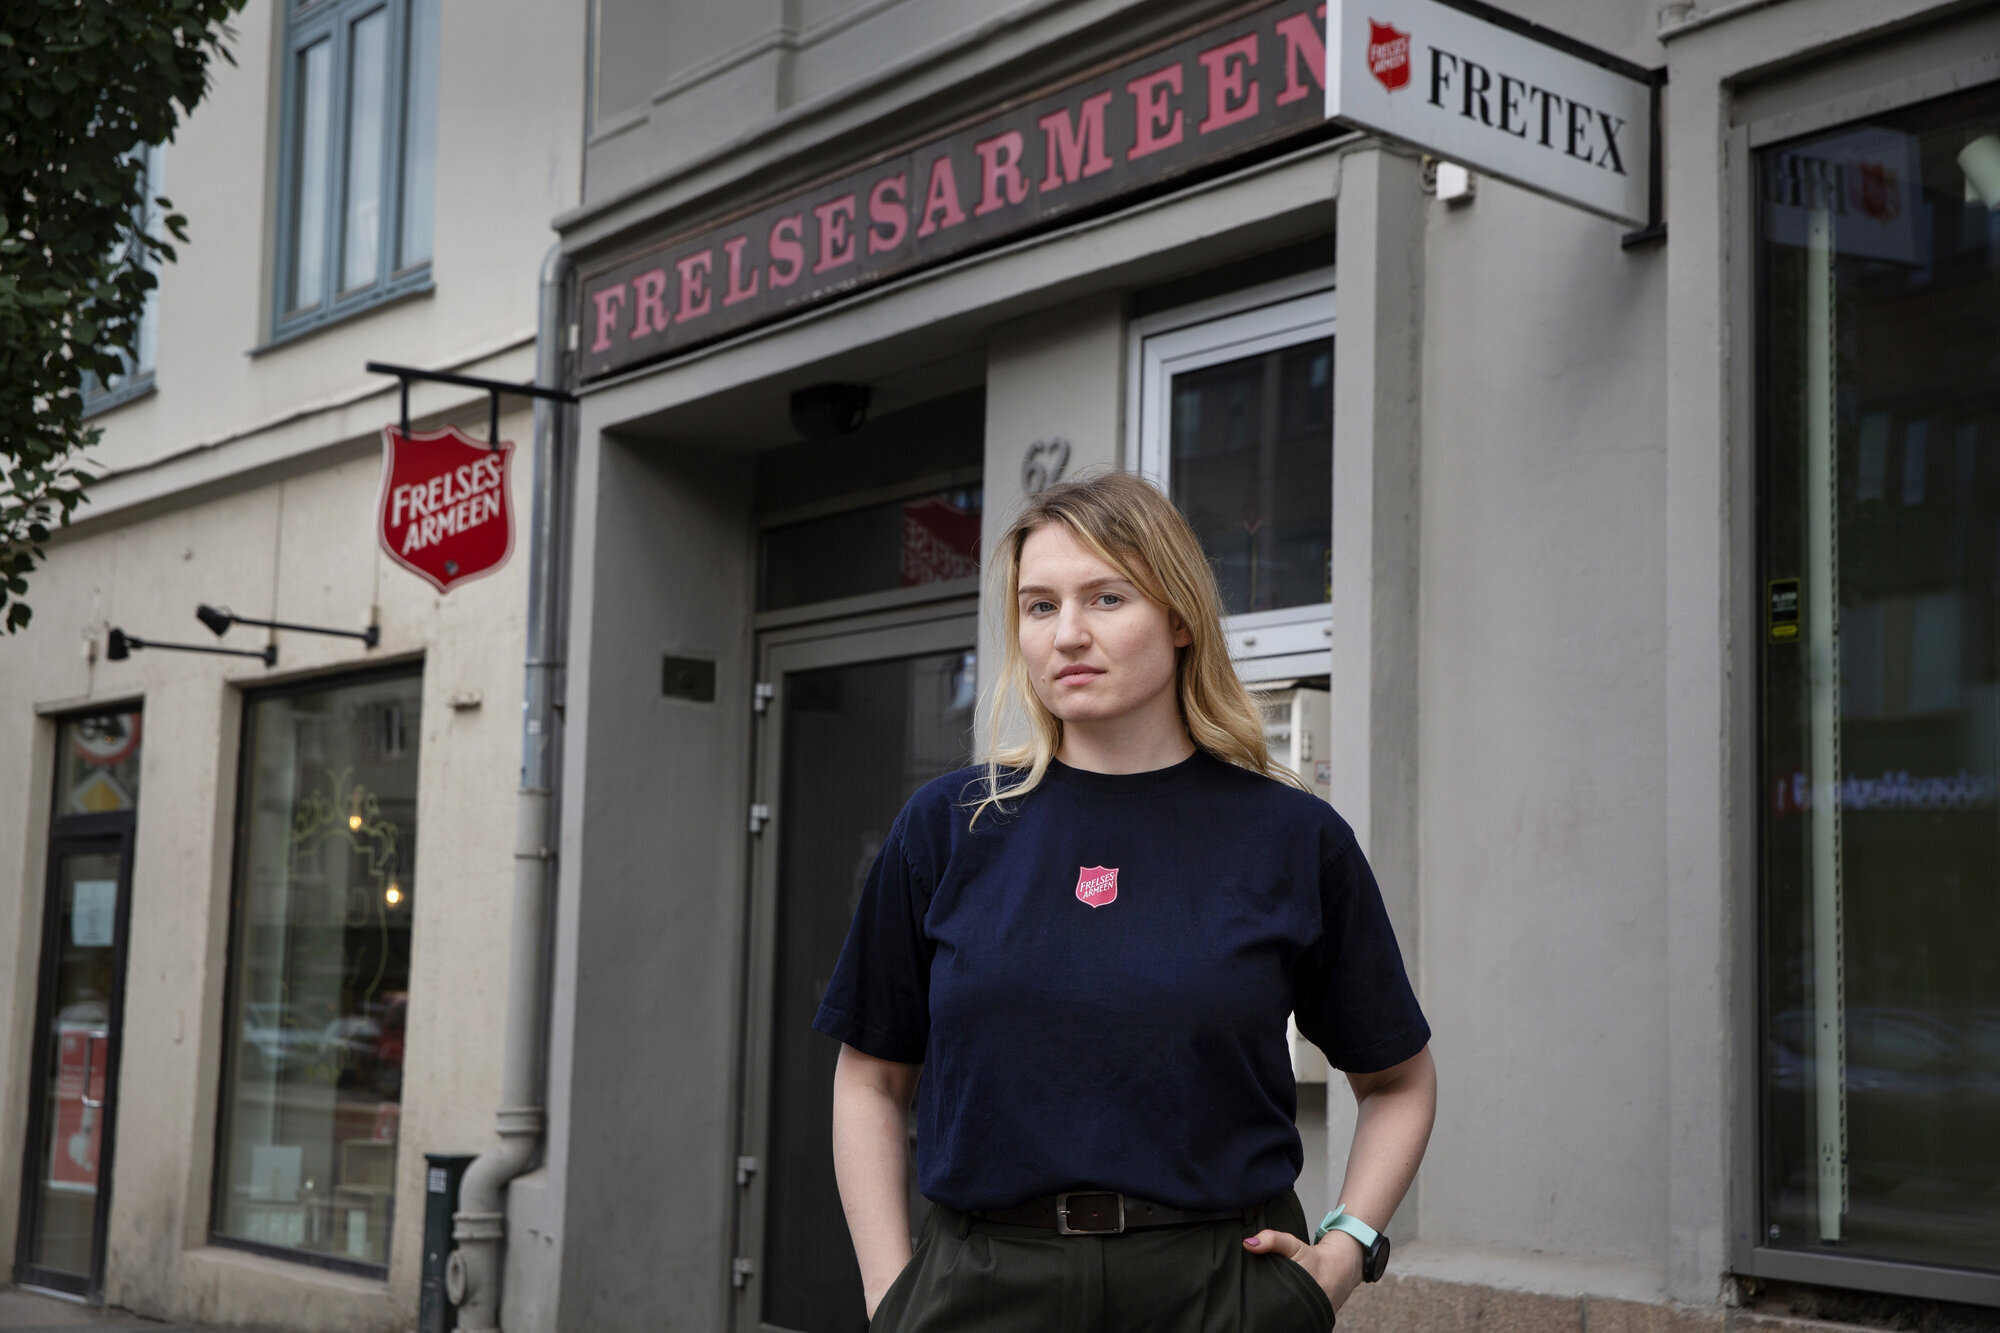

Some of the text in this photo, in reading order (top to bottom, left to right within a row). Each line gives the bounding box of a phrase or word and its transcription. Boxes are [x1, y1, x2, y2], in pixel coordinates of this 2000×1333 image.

[1427, 46, 1628, 177] FRETEX
[590, 5, 1326, 353] FRELSESARMEEN
[402, 488, 500, 556] ARMEEN
[1082, 881, 1114, 899] ARMEEN
